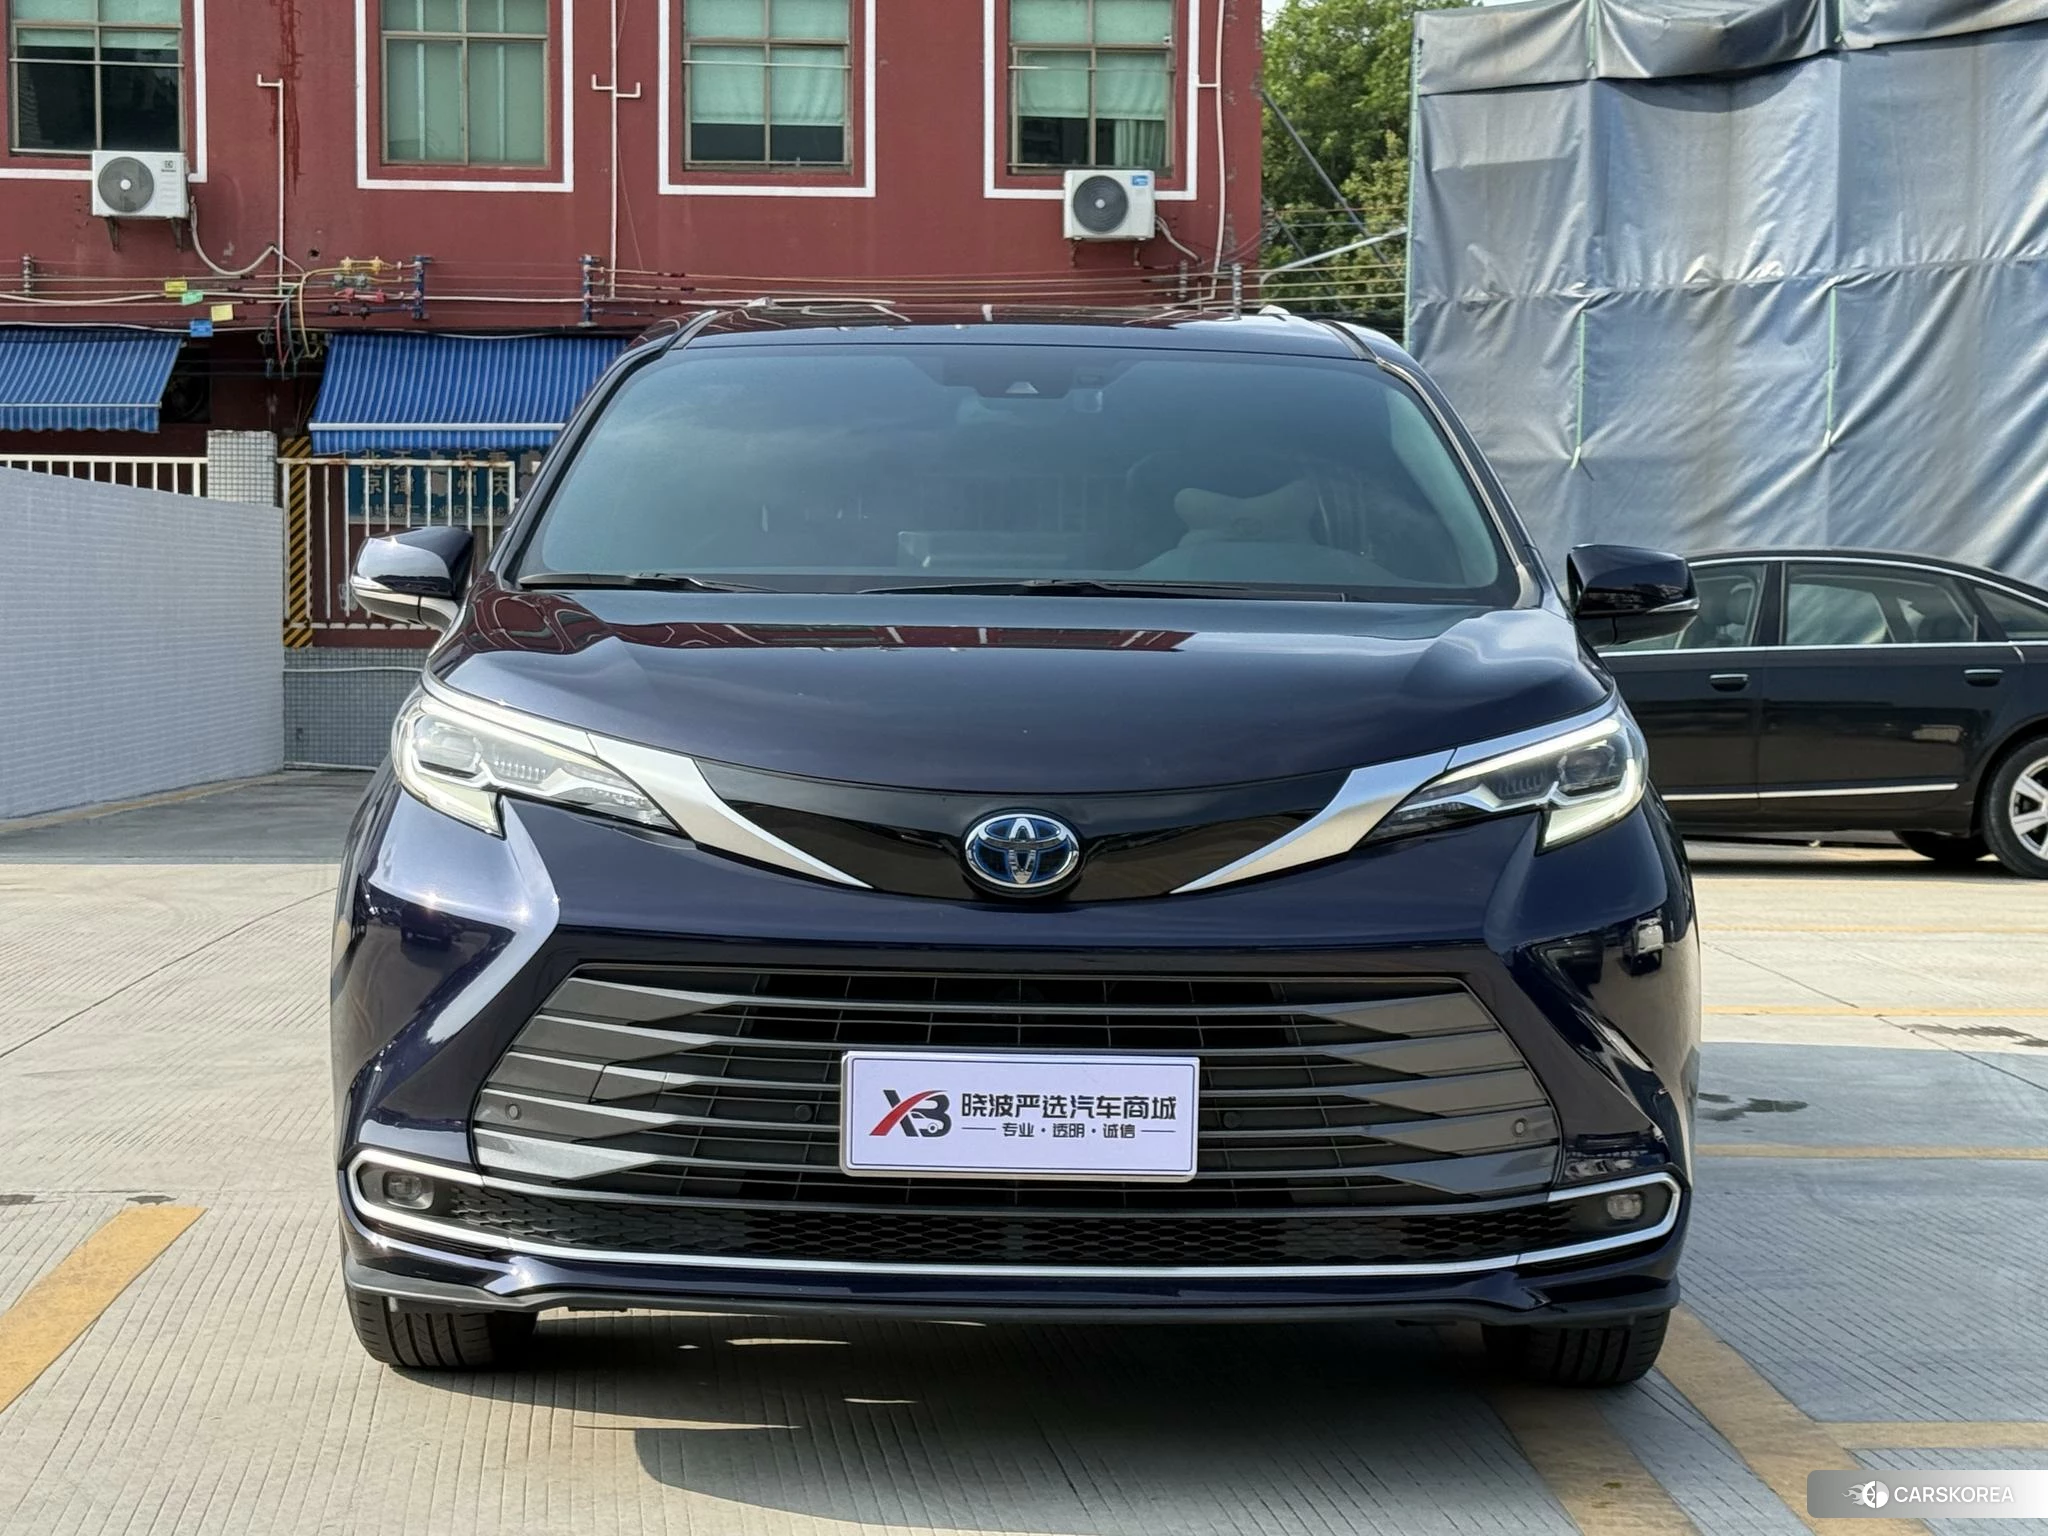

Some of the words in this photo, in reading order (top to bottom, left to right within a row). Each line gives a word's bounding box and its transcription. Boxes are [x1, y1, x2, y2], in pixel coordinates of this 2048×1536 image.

[961, 1093, 1177, 1121] 晓波严选汽车商城
